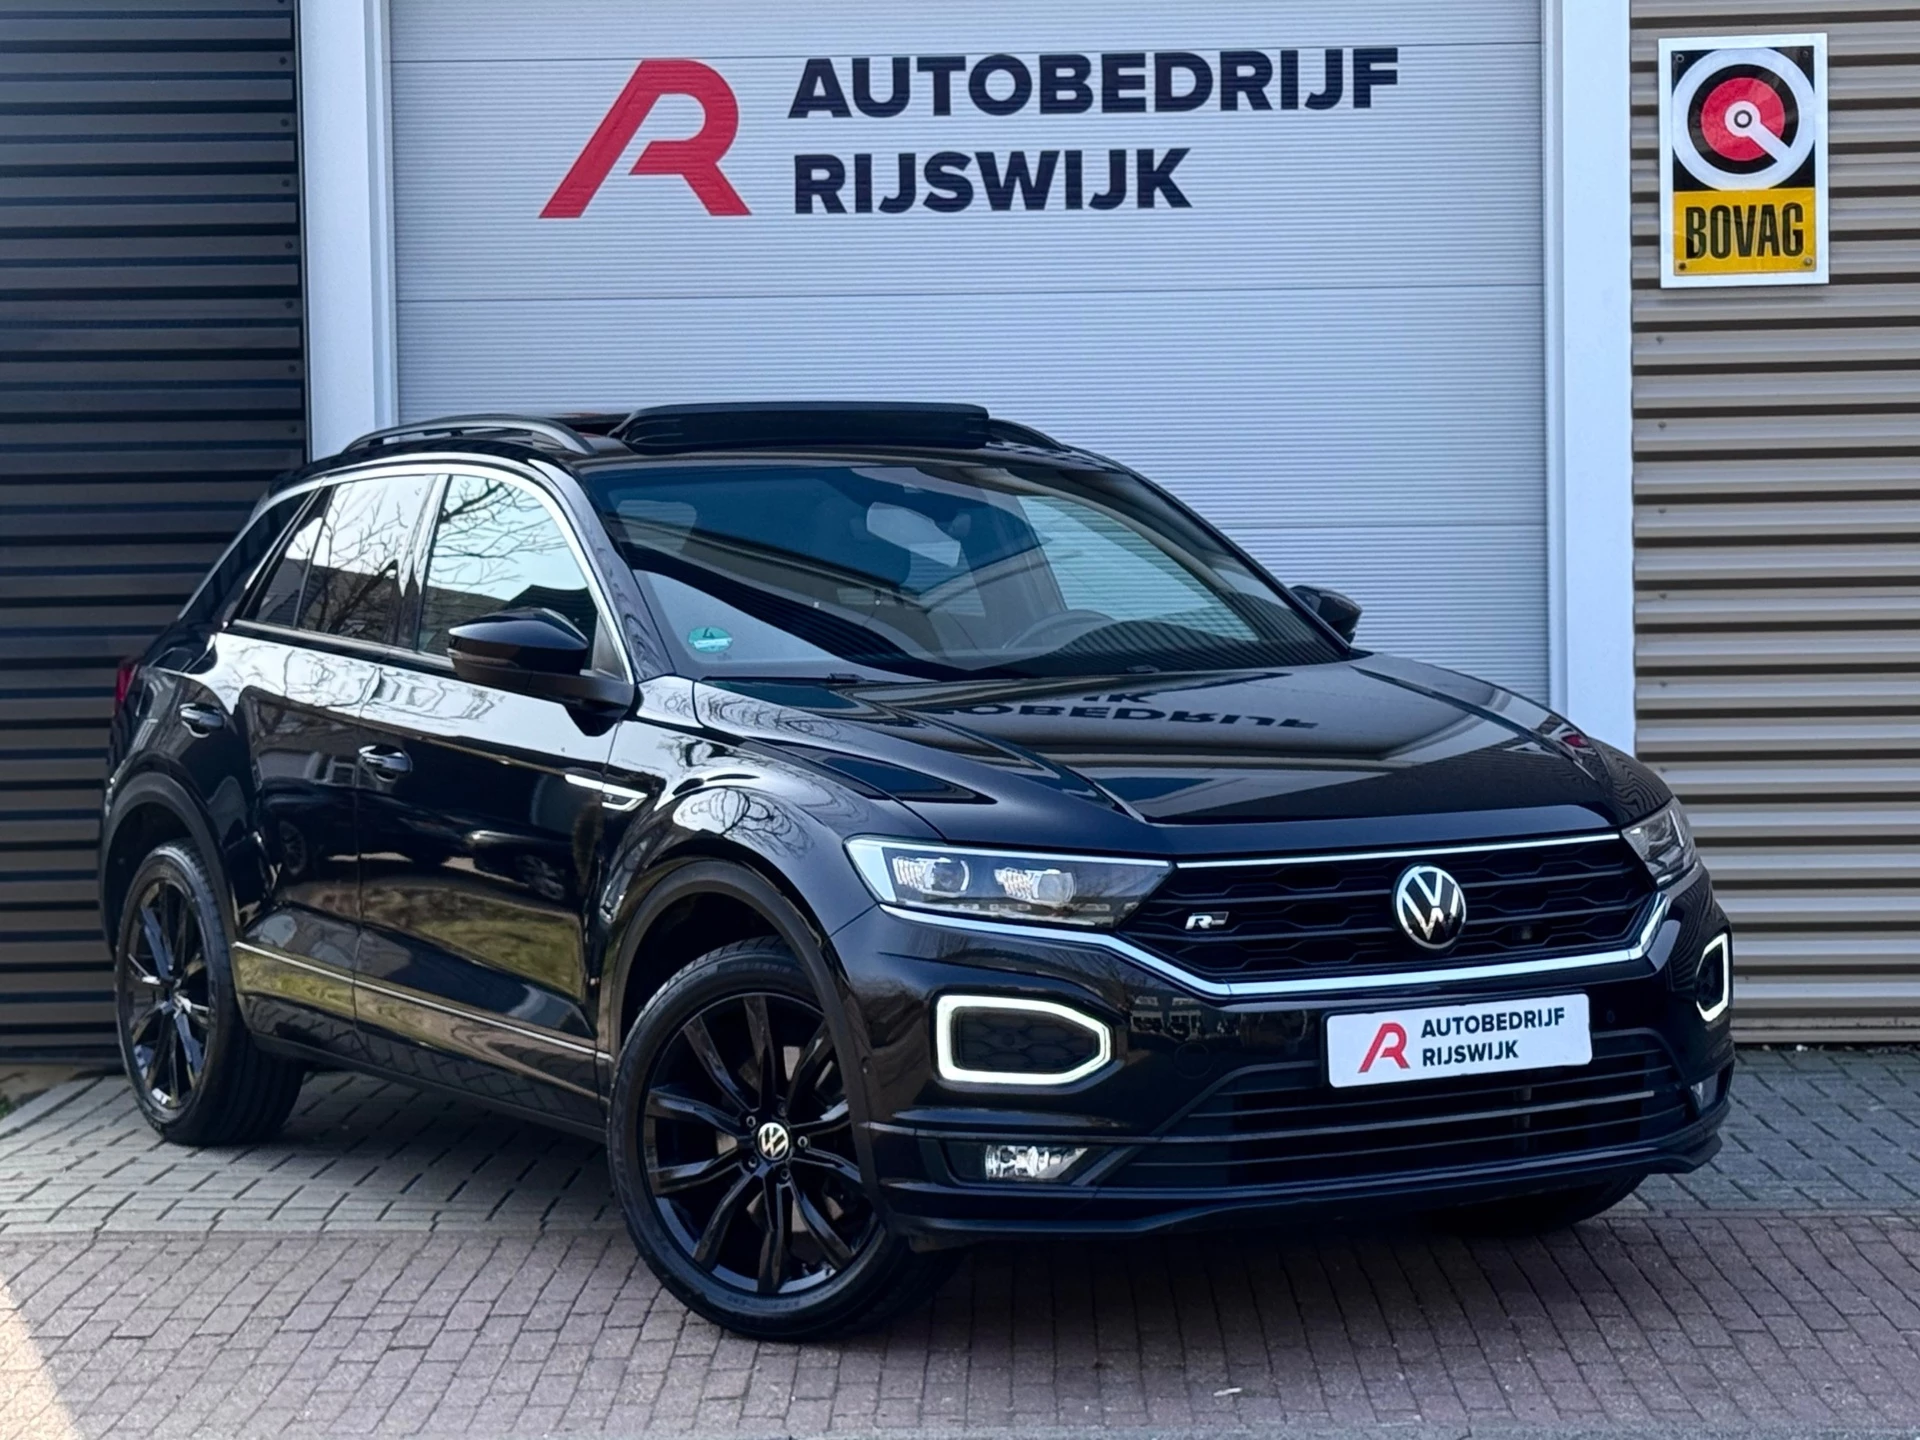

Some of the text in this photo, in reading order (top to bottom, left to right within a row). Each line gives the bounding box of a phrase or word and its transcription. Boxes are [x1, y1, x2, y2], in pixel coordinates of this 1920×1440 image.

[788, 48, 1399, 119] AUTOBEDRIJF
[794, 147, 1194, 215] RIJSWIJK
[1685, 203, 1804, 259] BOVAG
[1420, 1007, 1566, 1039] AUTOBEDRIJF
[1422, 1039, 1520, 1068] RIJSWIJK
